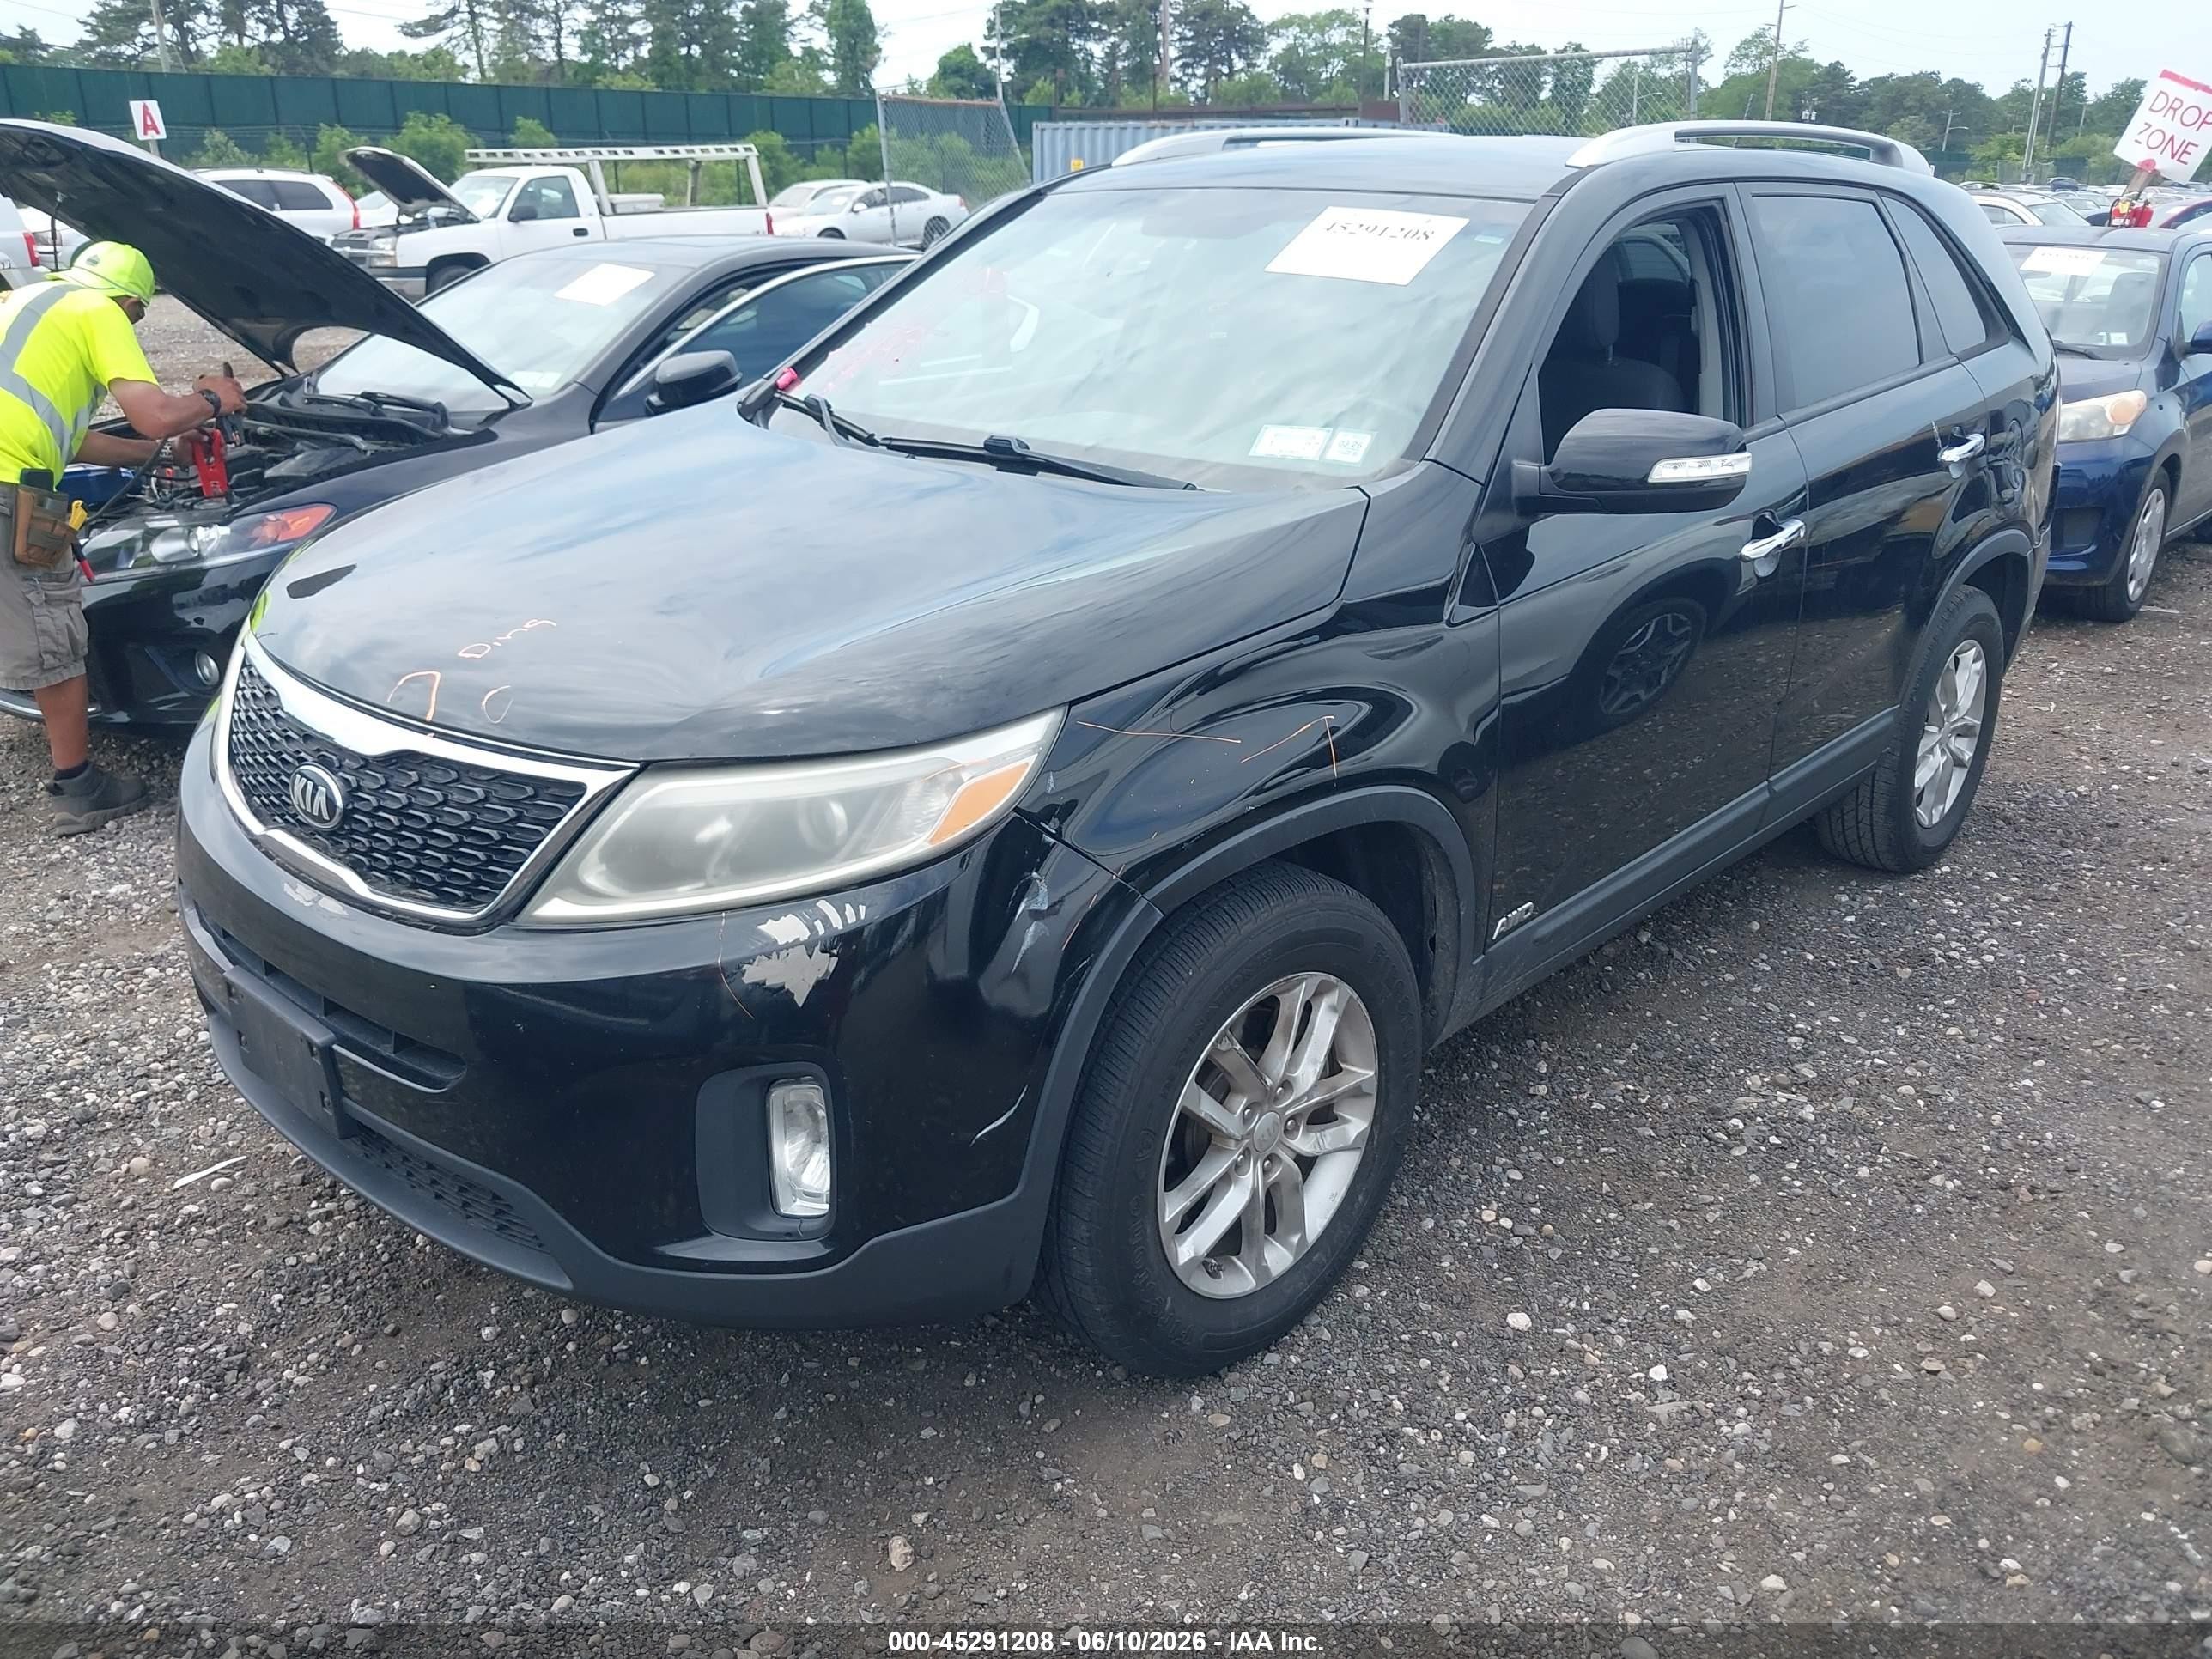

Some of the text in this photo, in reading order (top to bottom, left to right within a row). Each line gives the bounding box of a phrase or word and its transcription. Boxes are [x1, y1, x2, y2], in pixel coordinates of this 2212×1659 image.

[143, 101, 161, 136] A
[2148, 89, 2212, 132] DROP
[2134, 121, 2200, 166] ZONE
[293, 773, 331, 821] KIA
